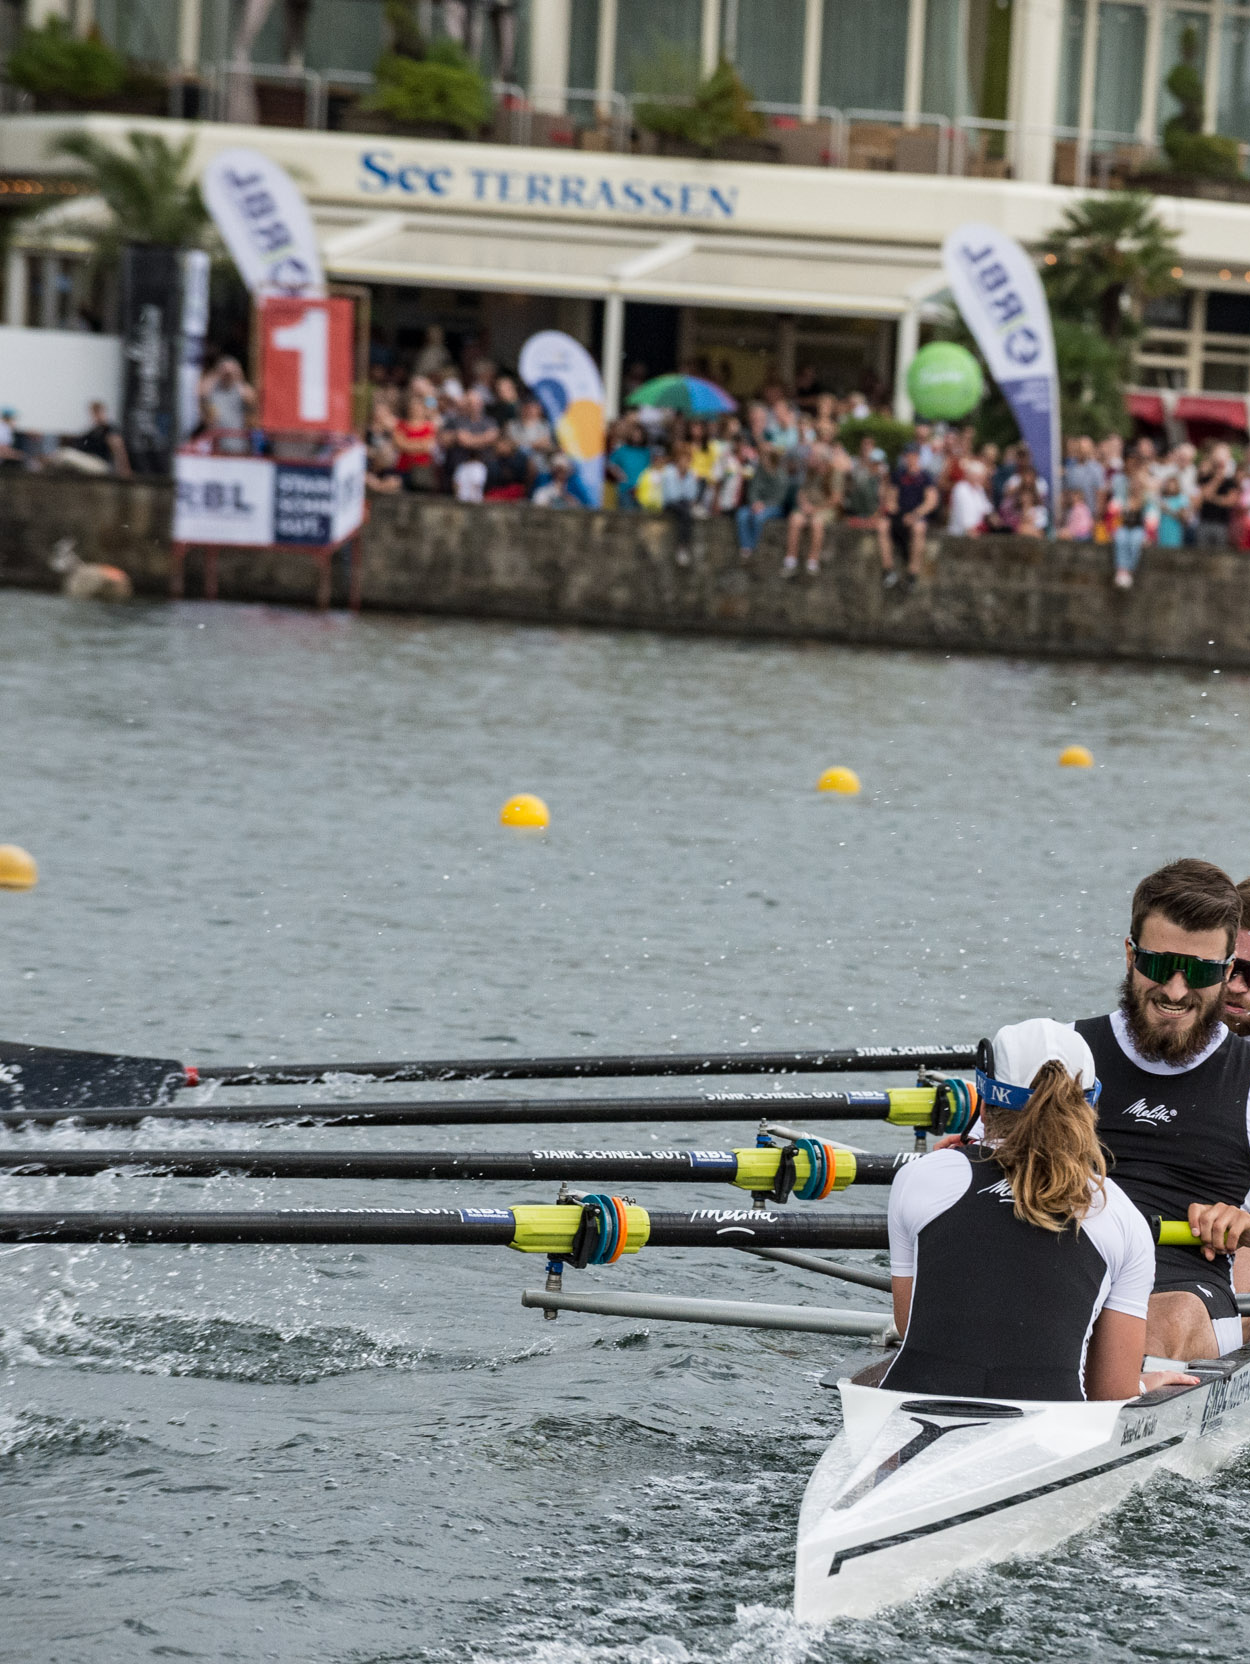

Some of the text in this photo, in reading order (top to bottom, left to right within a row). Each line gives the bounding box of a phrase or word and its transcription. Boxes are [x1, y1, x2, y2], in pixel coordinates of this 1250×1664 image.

[468, 166, 738, 219] TERRASSEN
[270, 307, 330, 423] 1
[991, 1084, 1012, 1105] NK
